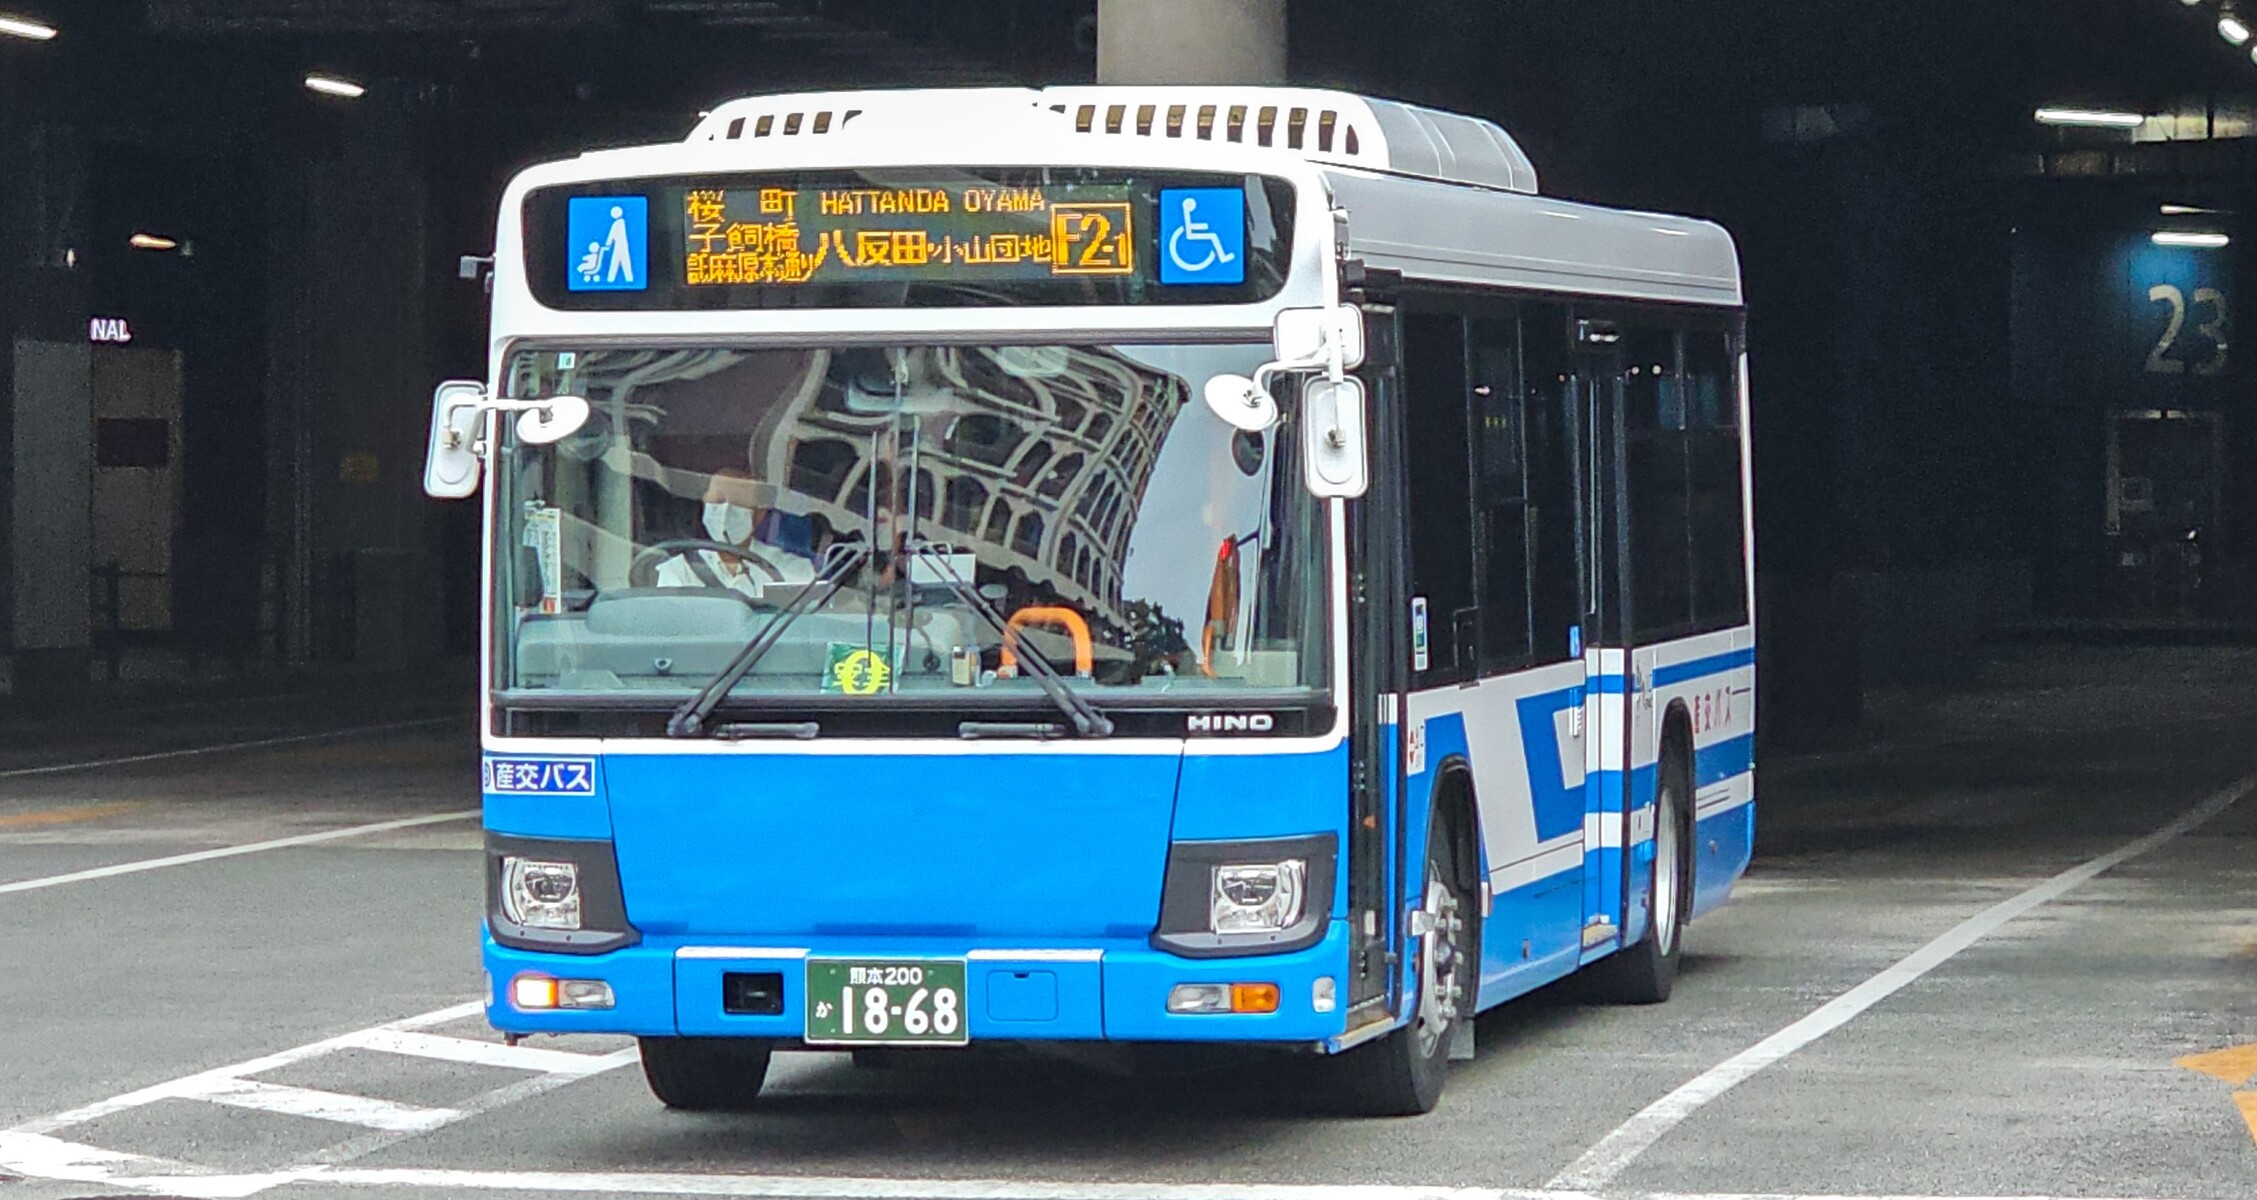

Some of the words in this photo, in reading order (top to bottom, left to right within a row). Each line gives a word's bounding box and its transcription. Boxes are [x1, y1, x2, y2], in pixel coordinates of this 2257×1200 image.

[820, 190, 950, 215] HATTANDA
[963, 188, 1046, 213] OYAMA
[688, 222, 800, 254] 子飼橋
[90, 317, 132, 342] NAL
[2145, 284, 2228, 376] 23
[1187, 714, 1274, 732] HINO
[495, 762, 591, 791] 産交バス
[814, 1000, 834, 1019] か
[841, 986, 959, 1036] 18-68
